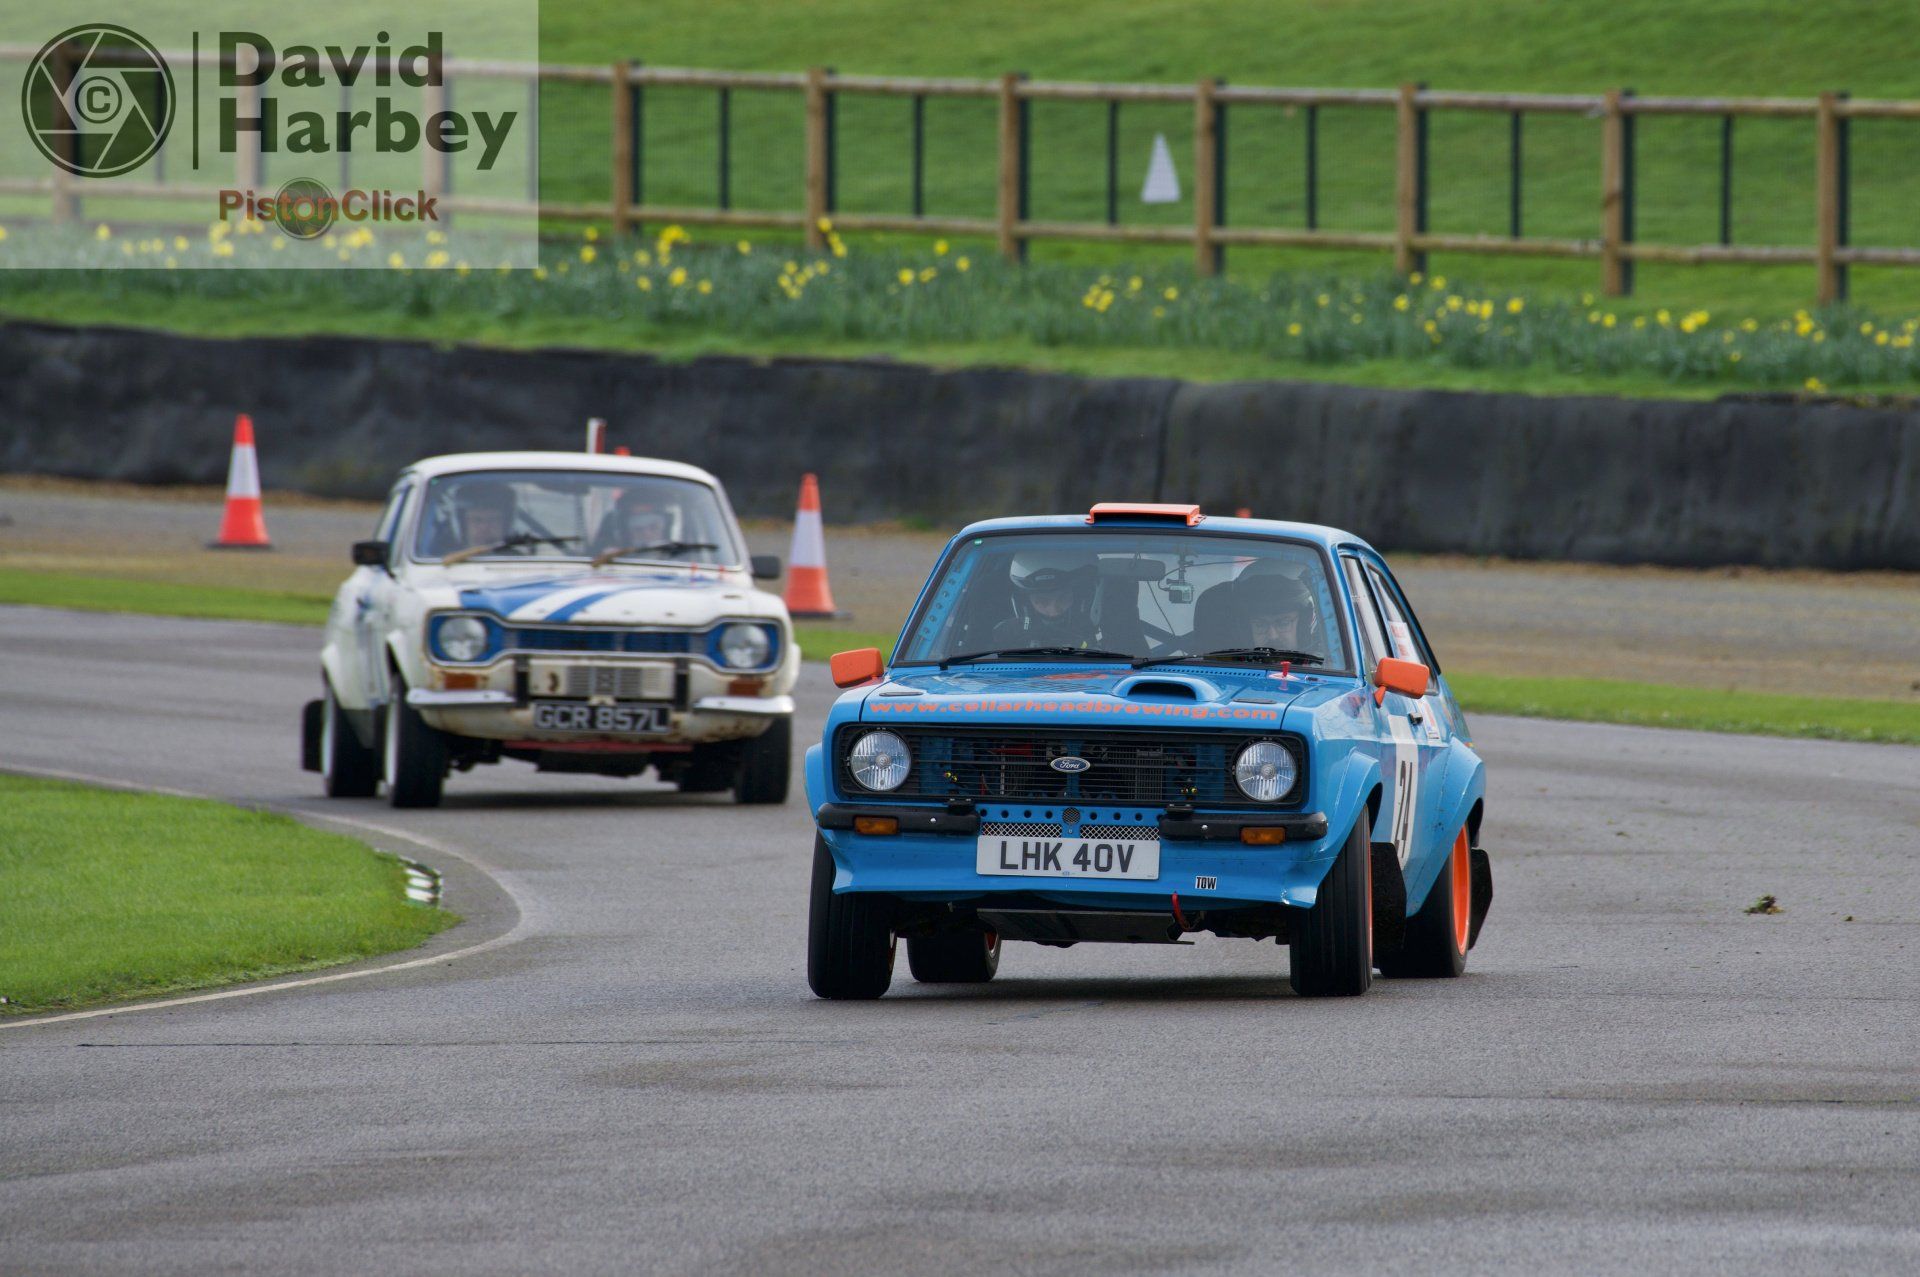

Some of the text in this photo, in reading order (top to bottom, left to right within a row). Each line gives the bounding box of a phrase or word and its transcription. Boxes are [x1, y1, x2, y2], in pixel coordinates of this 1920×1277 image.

[534, 704, 672, 733] GCR 857L
[869, 699, 1278, 721] www.cellarheadbrewing.com
[1000, 840, 1135, 873] LHK 40V
[1196, 876, 1217, 890] TOW
